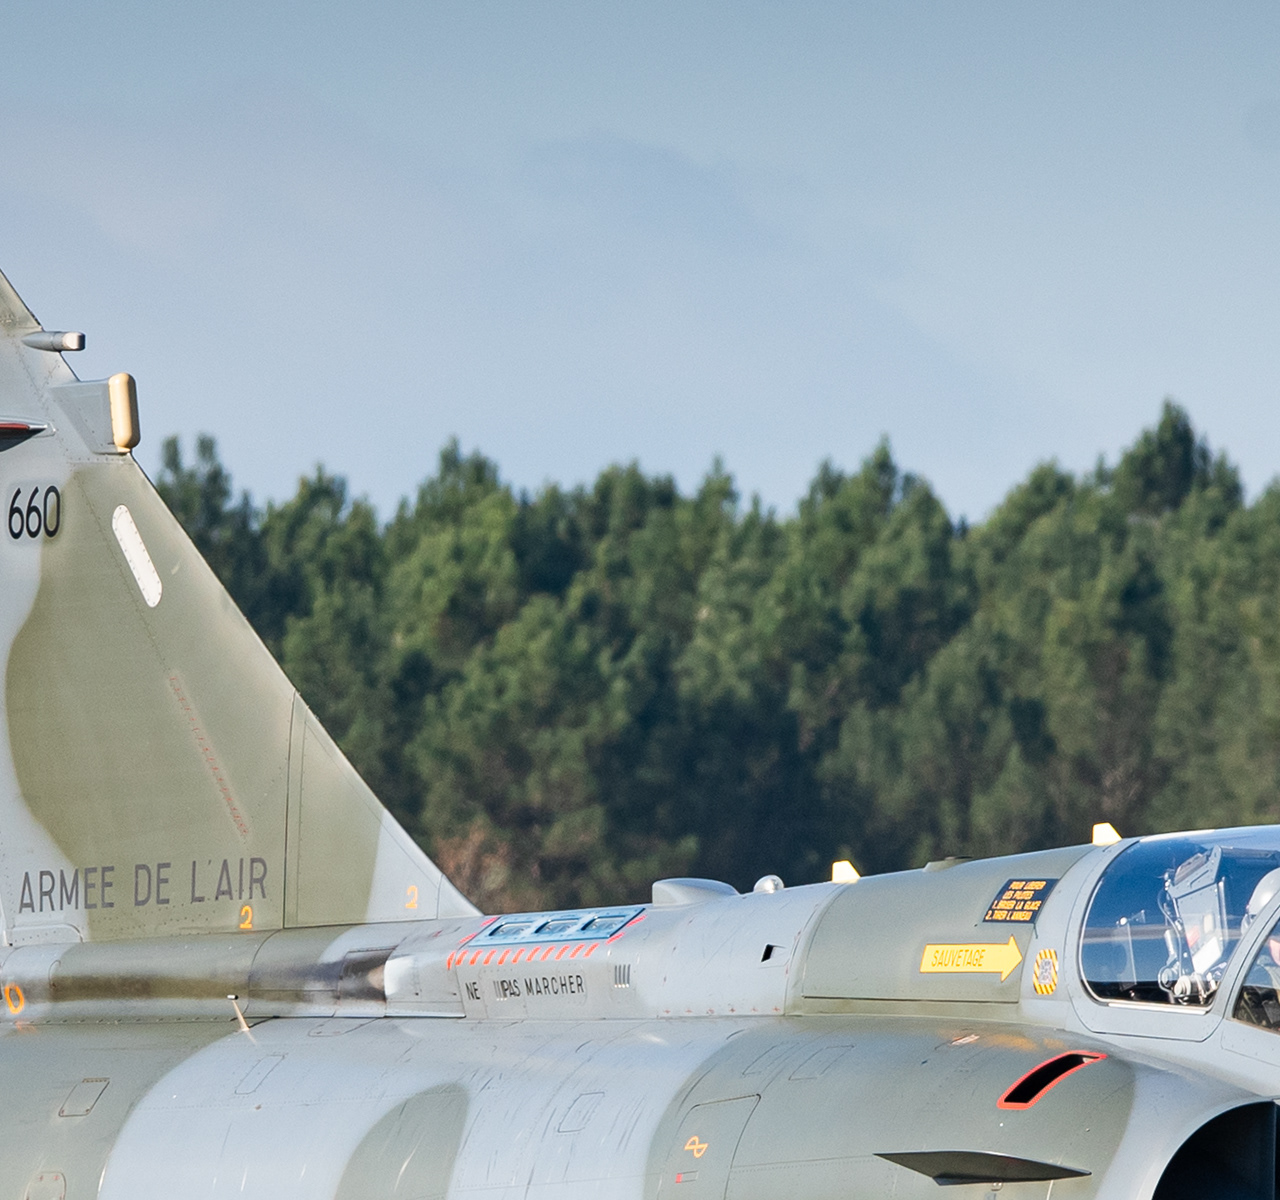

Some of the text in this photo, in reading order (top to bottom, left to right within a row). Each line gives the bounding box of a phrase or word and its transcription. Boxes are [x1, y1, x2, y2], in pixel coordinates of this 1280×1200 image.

[8, 485, 61, 540] 660
[19, 857, 268, 914] ARMEE DE L'AIR
[405, 885, 418, 909] 2
[239, 905, 253, 929] 2
[931, 949, 986, 967] SAUVETAGE
[465, 975, 584, 1000] NE PAS MARCHER
